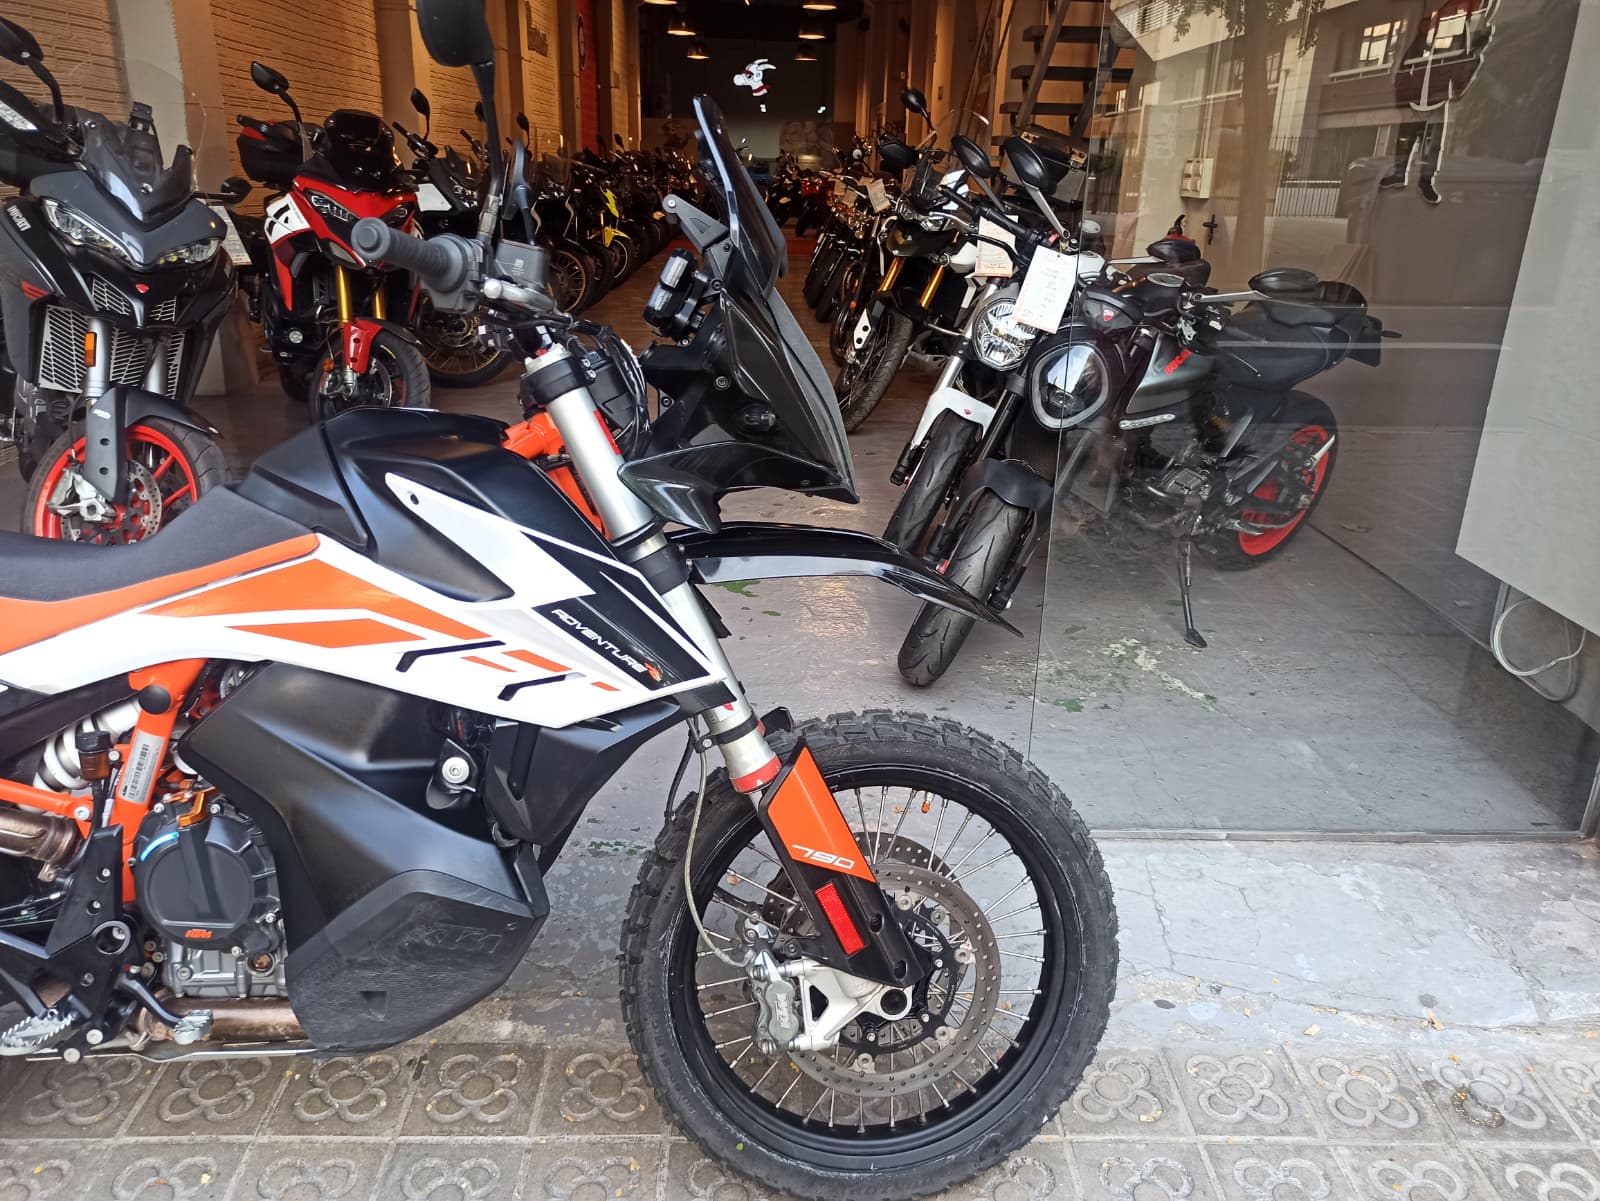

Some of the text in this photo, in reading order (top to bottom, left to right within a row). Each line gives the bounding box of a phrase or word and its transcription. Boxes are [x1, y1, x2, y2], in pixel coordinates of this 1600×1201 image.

[7, 204, 31, 231] DUCATI
[551, 608, 648, 673] ADVENTURE
[791, 844, 856, 870] 790
